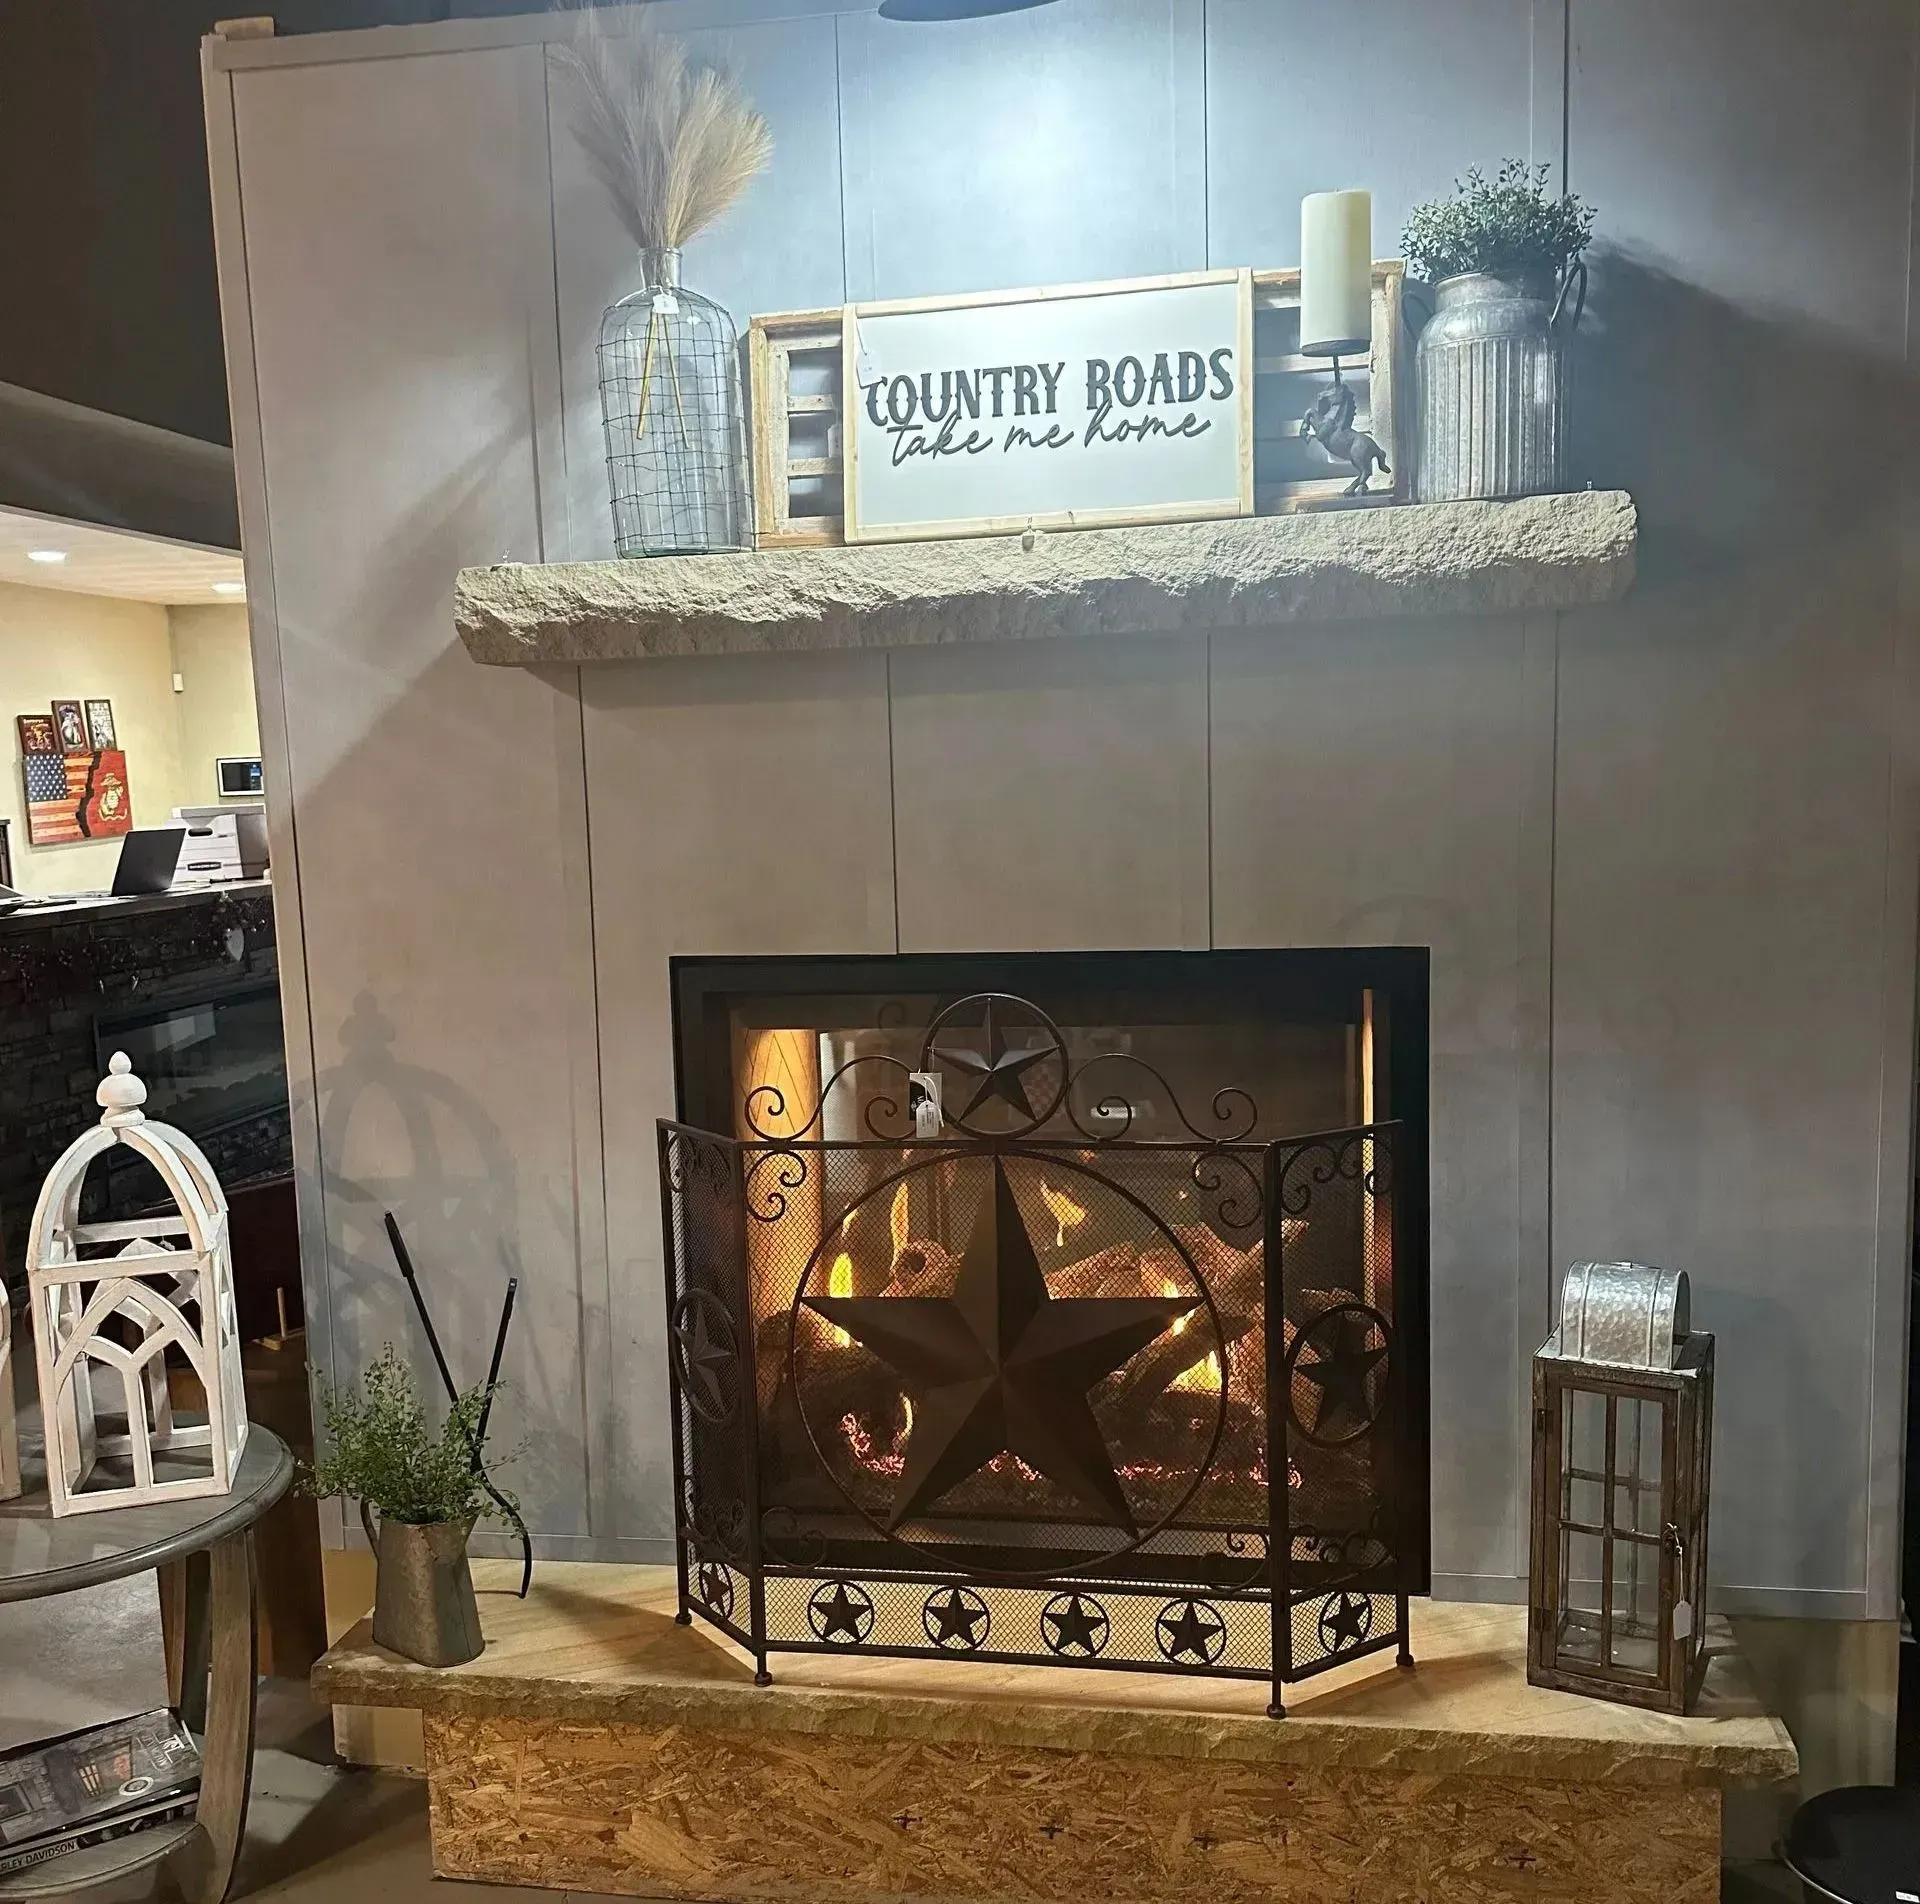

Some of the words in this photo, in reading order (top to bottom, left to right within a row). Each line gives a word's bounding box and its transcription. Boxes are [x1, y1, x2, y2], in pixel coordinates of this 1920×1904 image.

[866, 361, 1066, 426] COUNTRY
[1086, 348, 1234, 410] ROADS
[887, 408, 994, 467] take
[1003, 423, 1075, 453] me
[1084, 398, 1212, 448] home
[26, 1841, 75, 1864] DAVIDSON
